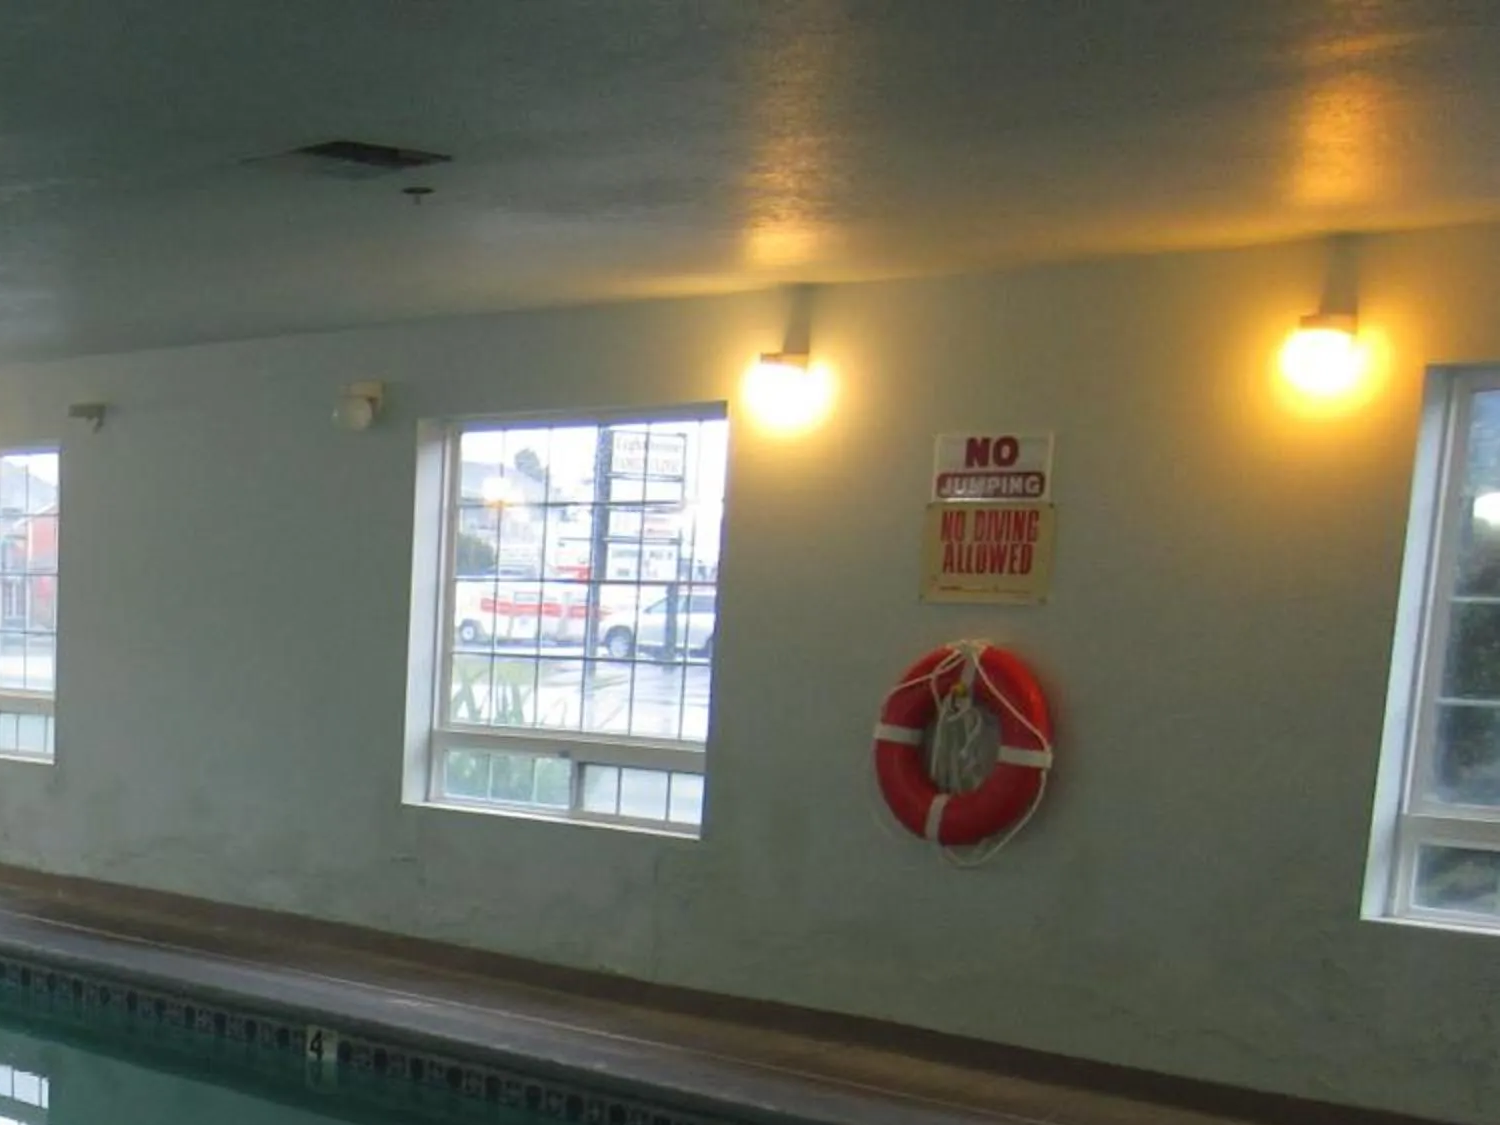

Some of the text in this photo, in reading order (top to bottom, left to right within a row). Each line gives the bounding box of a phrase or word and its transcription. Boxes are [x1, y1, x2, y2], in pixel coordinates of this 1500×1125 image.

[965, 436, 1019, 468] NO
[940, 475, 1041, 495] JUMPING
[941, 509, 1039, 543] NO DIVING
[942, 543, 1034, 575] ALLOWED
[309, 1029, 324, 1061] 4
